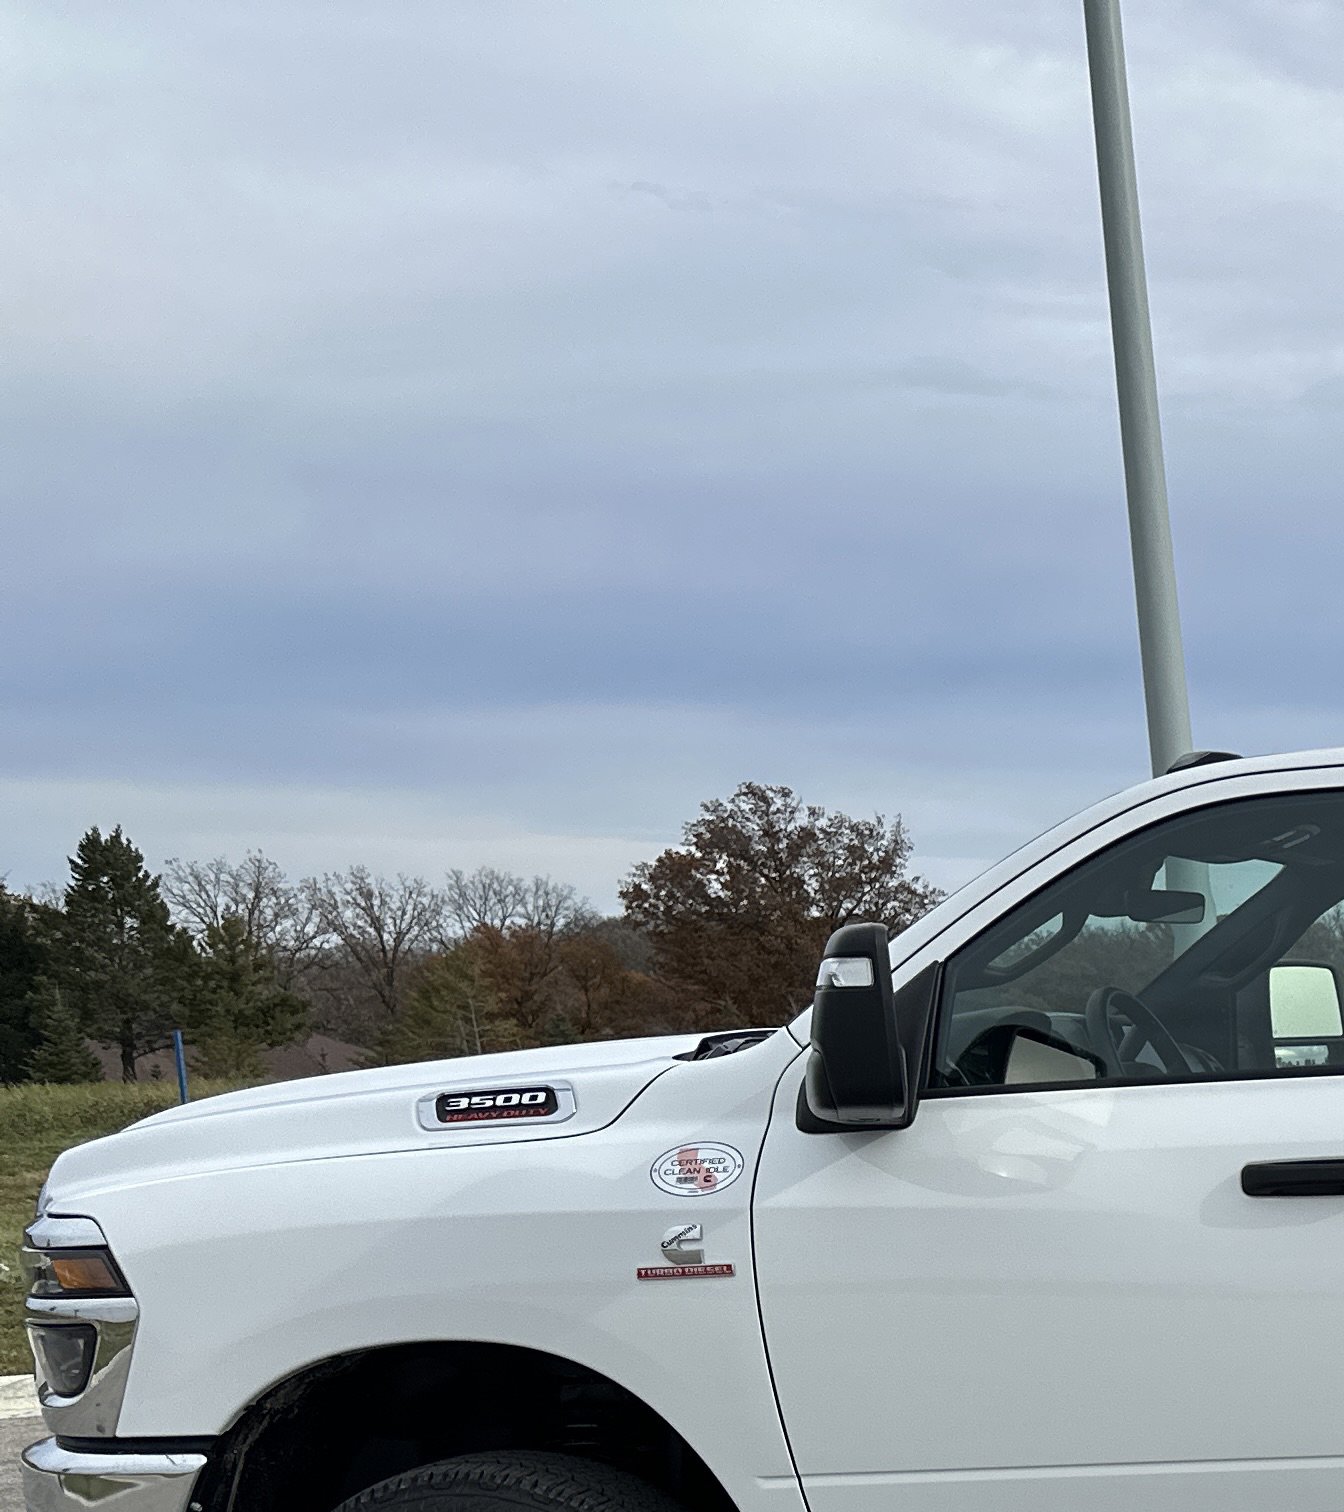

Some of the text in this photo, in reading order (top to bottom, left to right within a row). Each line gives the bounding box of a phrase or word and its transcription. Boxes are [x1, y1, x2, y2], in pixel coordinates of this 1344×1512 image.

[445, 1092, 546, 1110] 3500
[446, 1108, 548, 1121] HEAVY DUTY
[671, 1157, 726, 1167] CERTIFIED
[664, 1166, 730, 1176] CLEAN IDLE
[660, 1223, 697, 1249] Cummins
[640, 1265, 732, 1277] TURBO DIESEL
